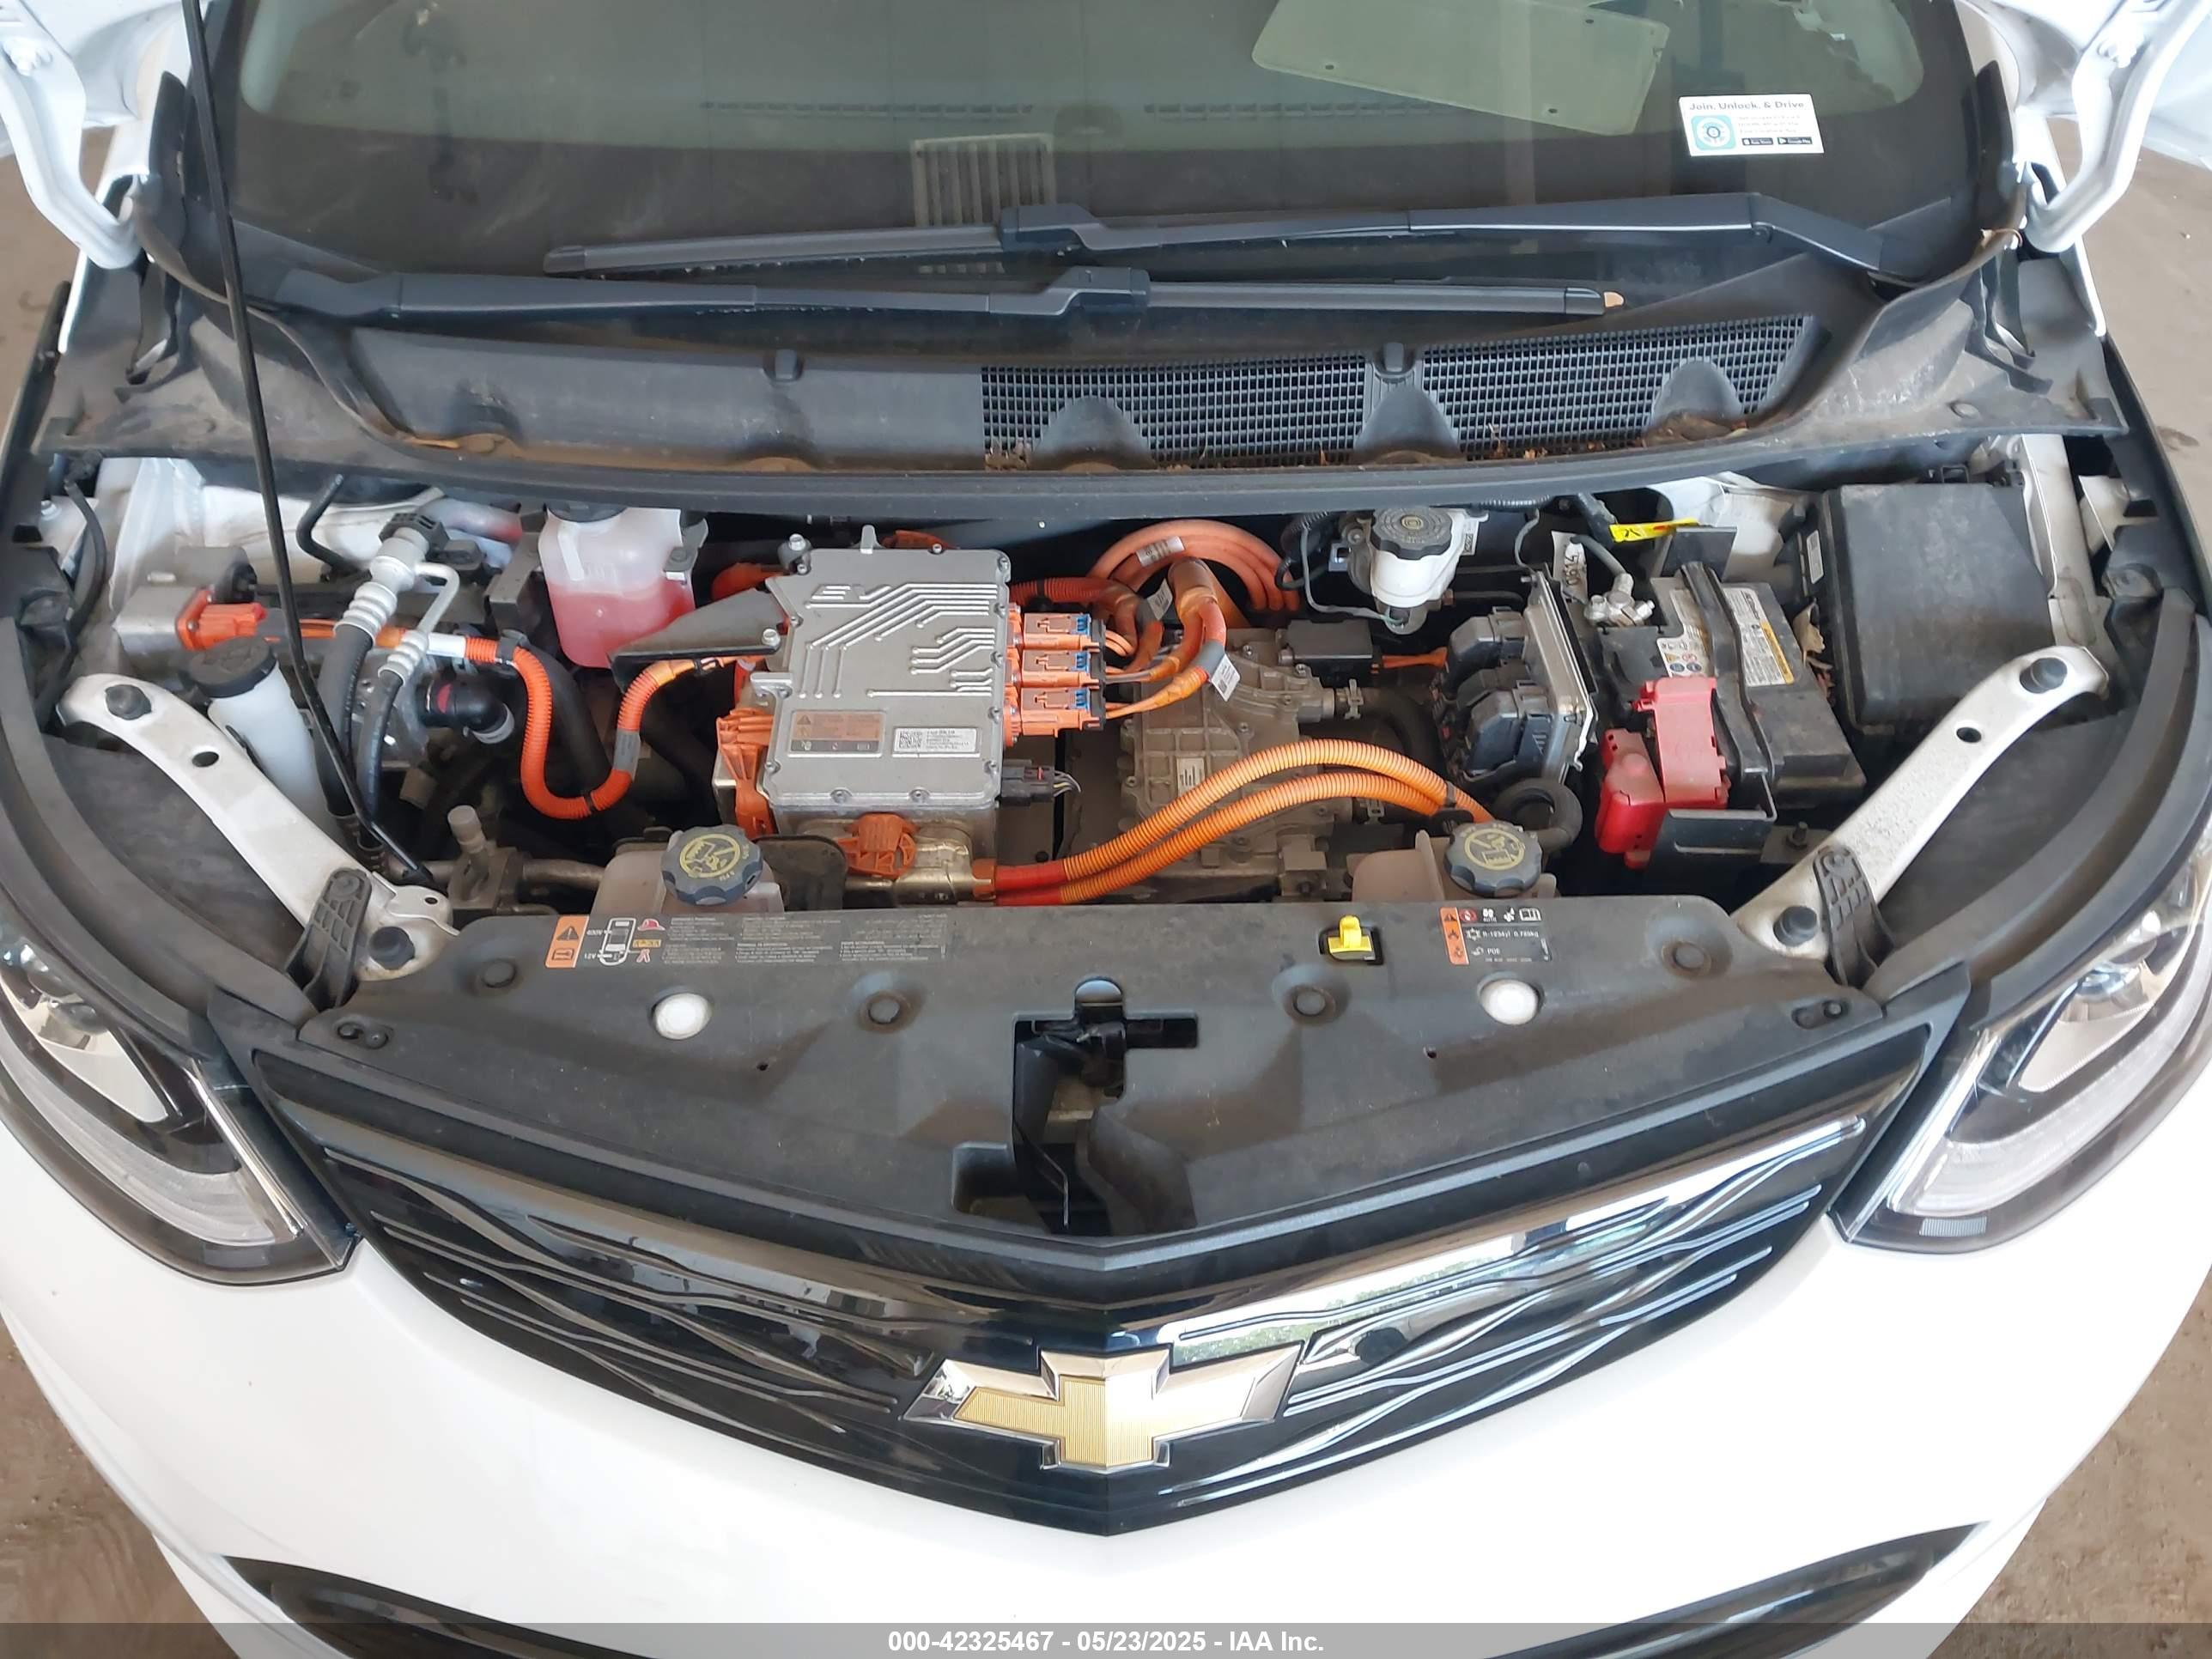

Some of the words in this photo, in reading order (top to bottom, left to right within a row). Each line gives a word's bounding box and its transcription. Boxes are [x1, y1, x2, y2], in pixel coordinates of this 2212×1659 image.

[1689, 101, 1716, 111] Join,
[1718, 100, 1760, 110] Unlock,
[1775, 100, 1804, 109] Drive
